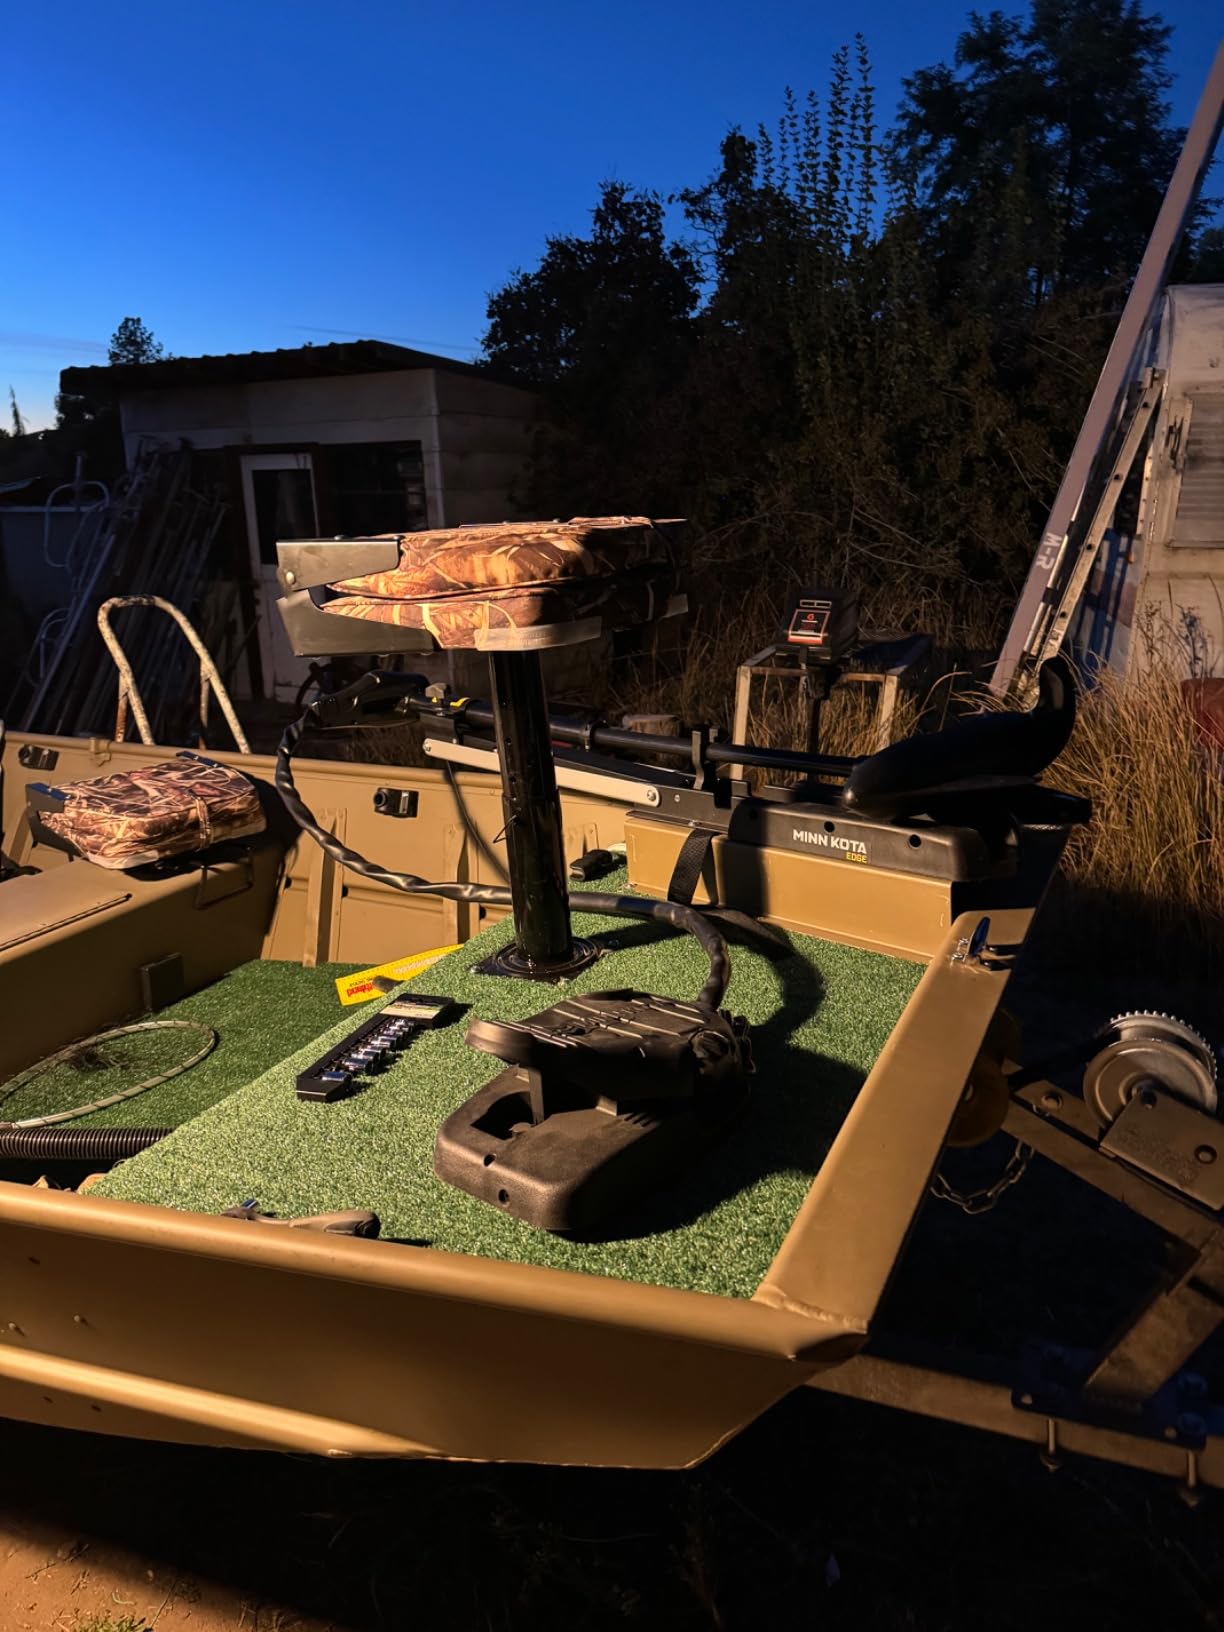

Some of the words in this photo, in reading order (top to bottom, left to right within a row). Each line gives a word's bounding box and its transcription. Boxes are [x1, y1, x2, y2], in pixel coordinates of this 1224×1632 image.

[792, 829, 829, 847] MINN
[830, 836, 868, 854] KOTA
[845, 851, 868, 864] EDGE
